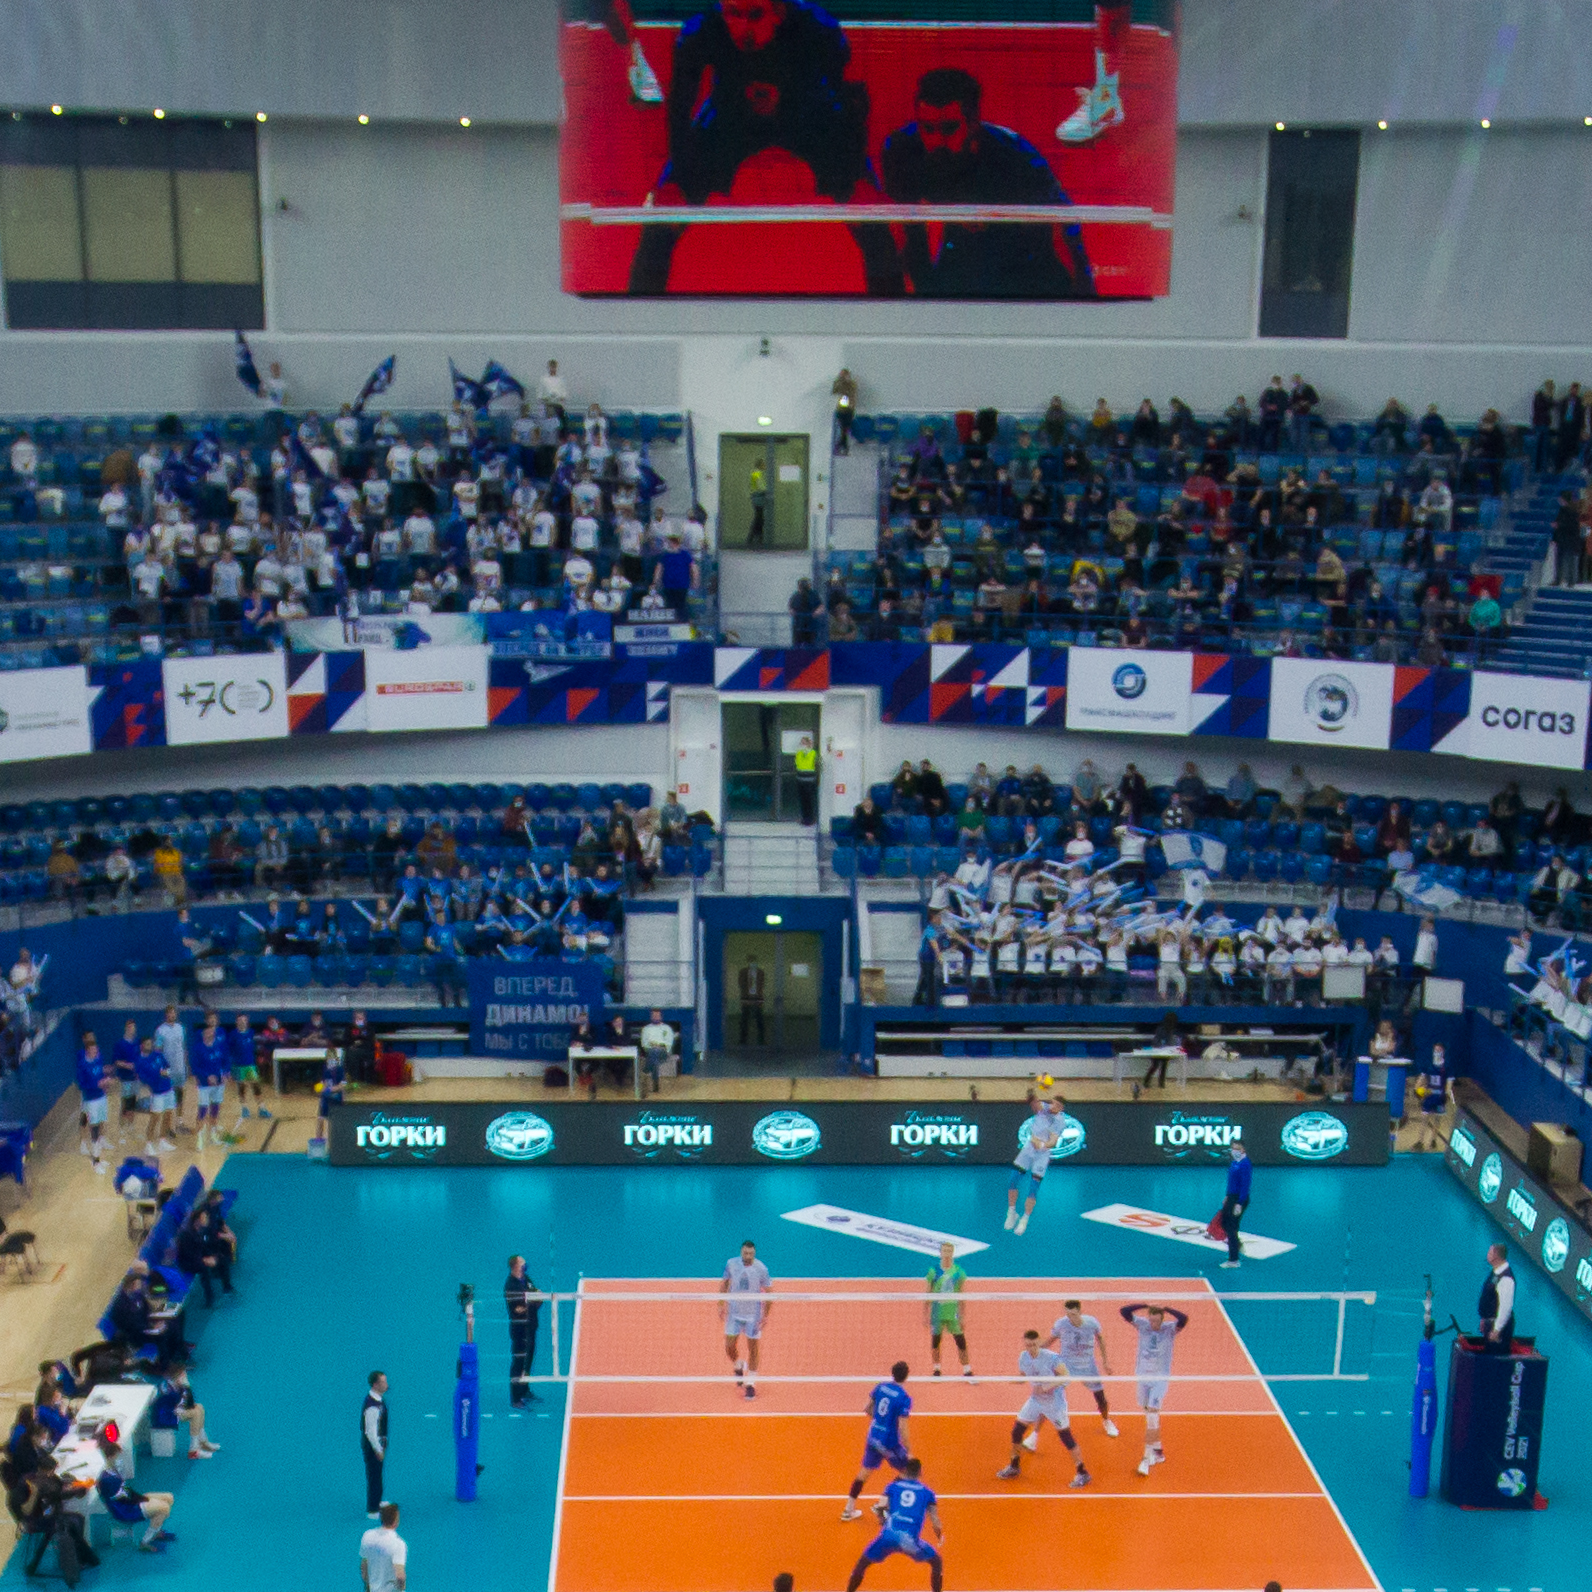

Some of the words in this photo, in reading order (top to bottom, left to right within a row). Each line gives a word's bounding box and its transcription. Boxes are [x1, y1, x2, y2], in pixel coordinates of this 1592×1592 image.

[356, 1125, 446, 1147] ГОРКИ
[624, 1124, 713, 1146] ГОРКИ
[890, 1124, 978, 1146] ГОРКИ
[1155, 1125, 1242, 1146] ГОРКИ
[1507, 1188, 1538, 1232] ГОРКИ
[877, 1397, 890, 1417] 6
[899, 1489, 916, 1508] 9
